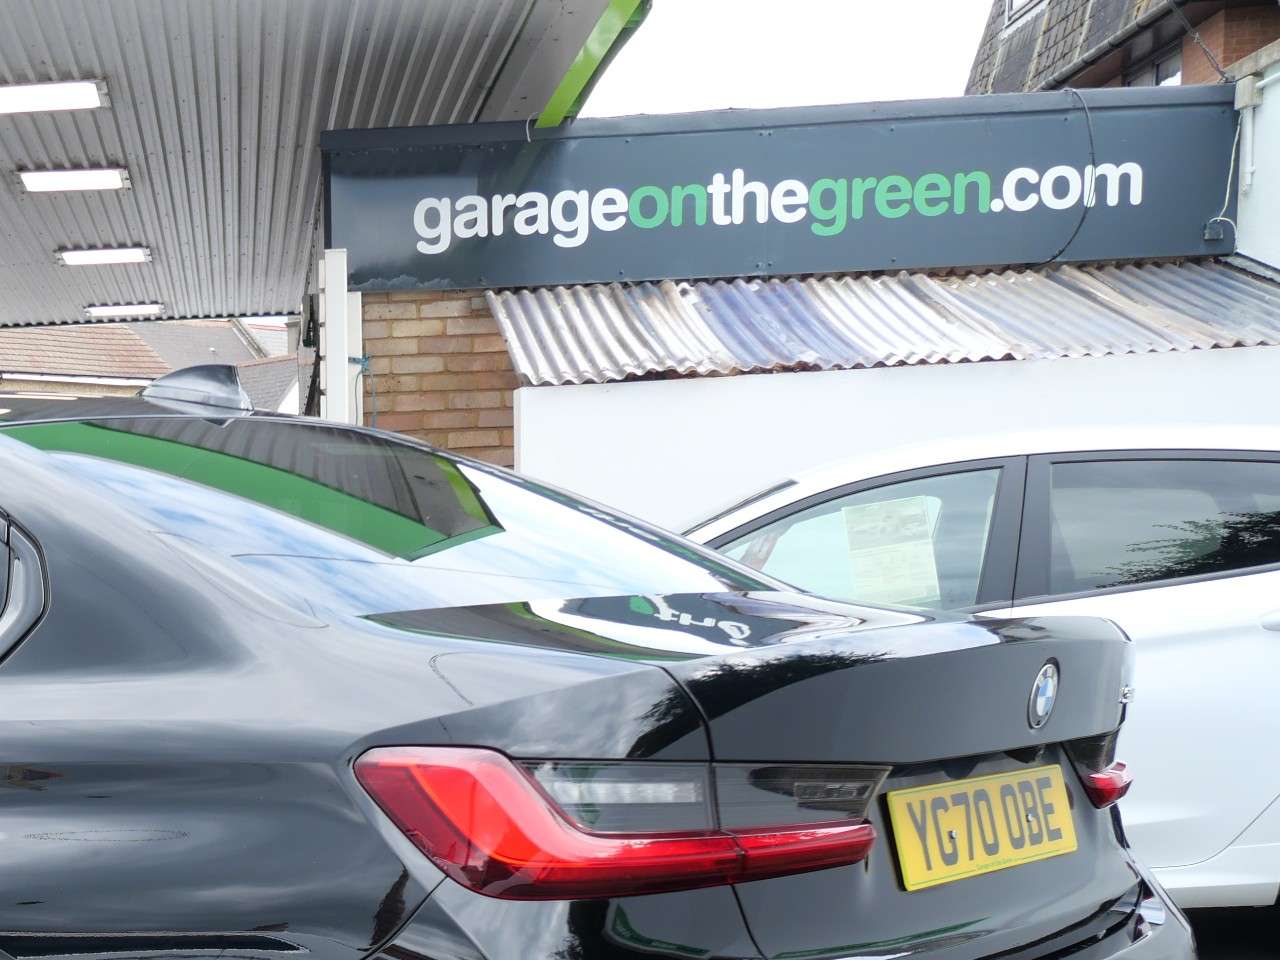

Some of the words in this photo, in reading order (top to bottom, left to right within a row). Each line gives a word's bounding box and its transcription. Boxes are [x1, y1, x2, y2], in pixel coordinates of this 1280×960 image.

[413, 161, 1143, 255] garageonthegreen.com
[906, 788, 999, 871] YG70
[1000, 776, 1062, 850] OBE
